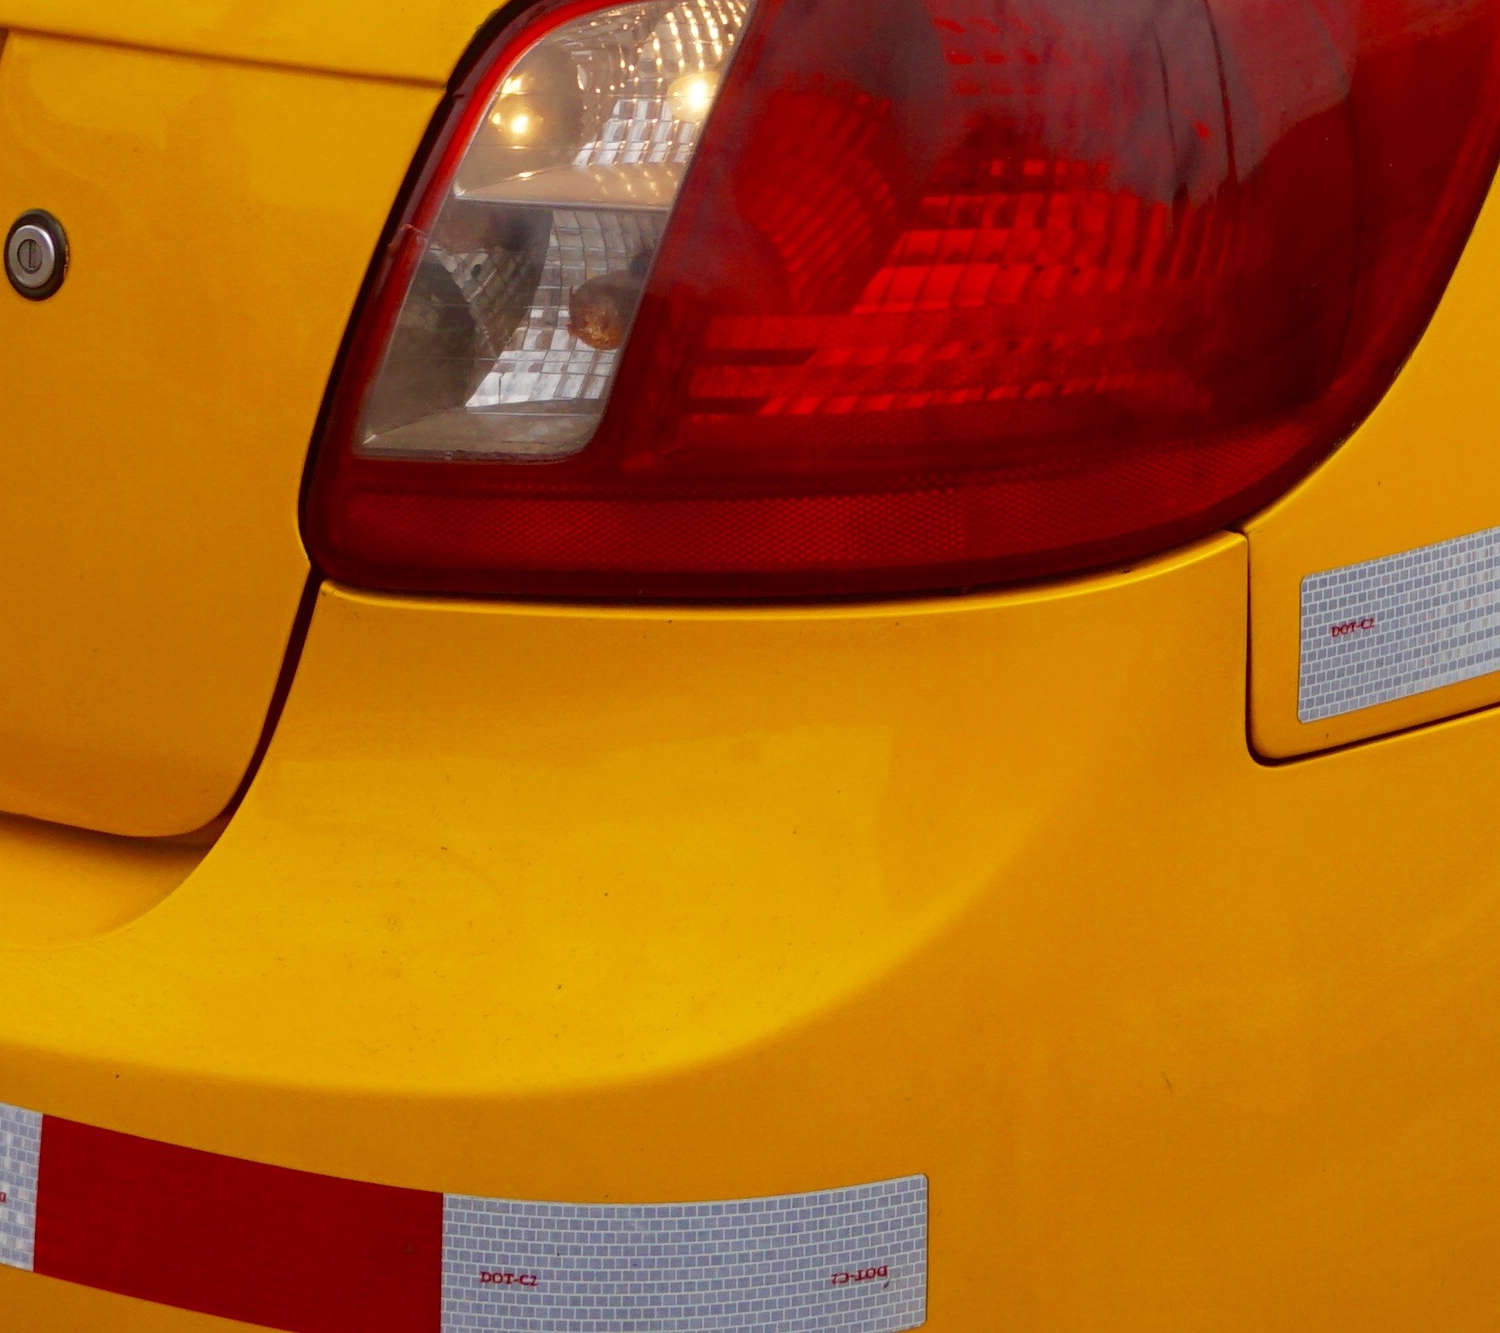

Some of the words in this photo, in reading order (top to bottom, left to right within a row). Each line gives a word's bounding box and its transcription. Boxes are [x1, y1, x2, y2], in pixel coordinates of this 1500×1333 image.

[1331, 618, 1375, 637] DOT-C2
[479, 1271, 539, 1287] DOT-C2
[831, 1265, 888, 1285] DOT-C2
